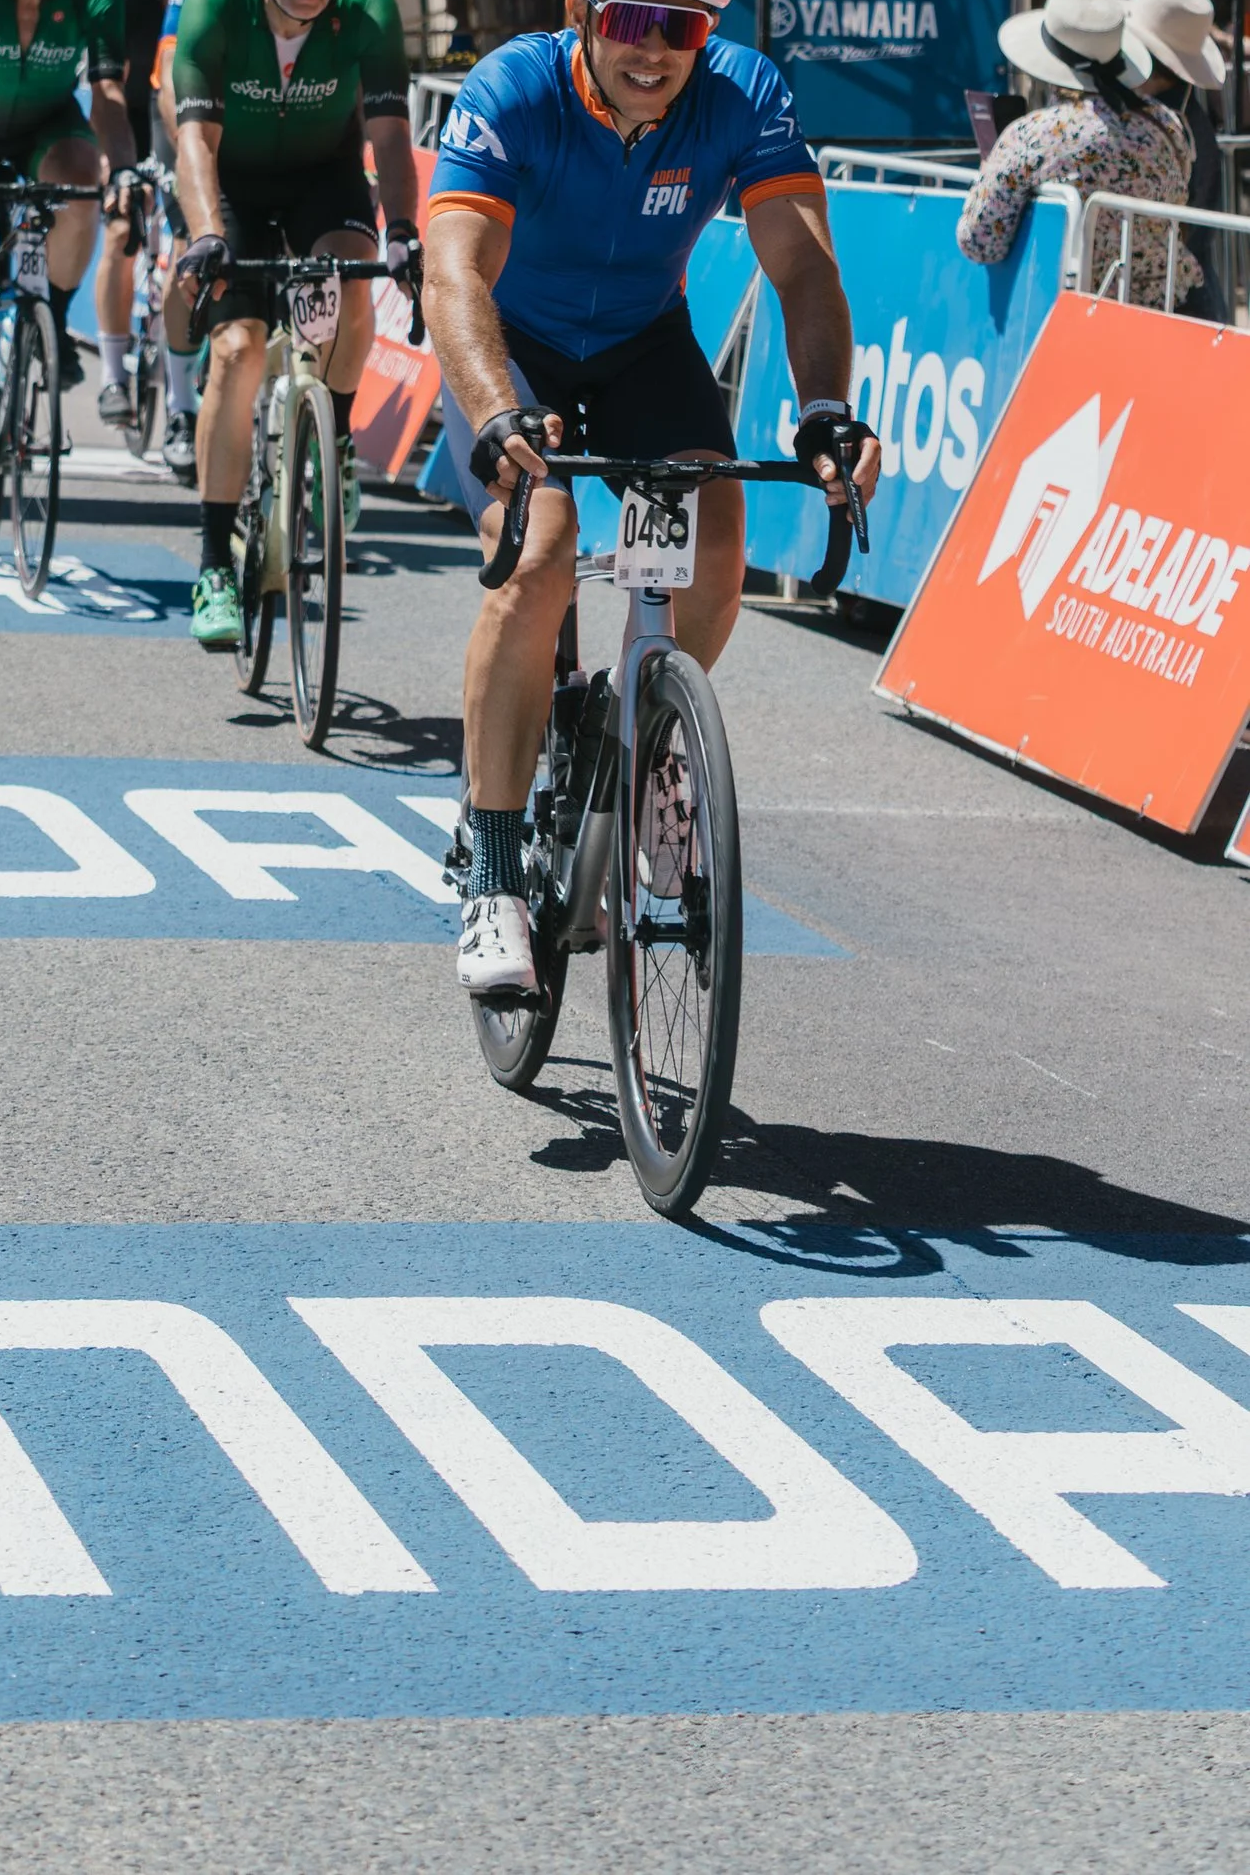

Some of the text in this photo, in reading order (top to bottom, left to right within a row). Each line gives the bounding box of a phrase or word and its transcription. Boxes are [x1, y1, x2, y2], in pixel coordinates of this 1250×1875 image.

[295, 290, 338, 325] 0843
[777, 316, 986, 491] ntos
[1067, 502, 1250, 638] ADELAIDE
[1045, 593, 1205, 688] SOUTH AUSTRALIA
